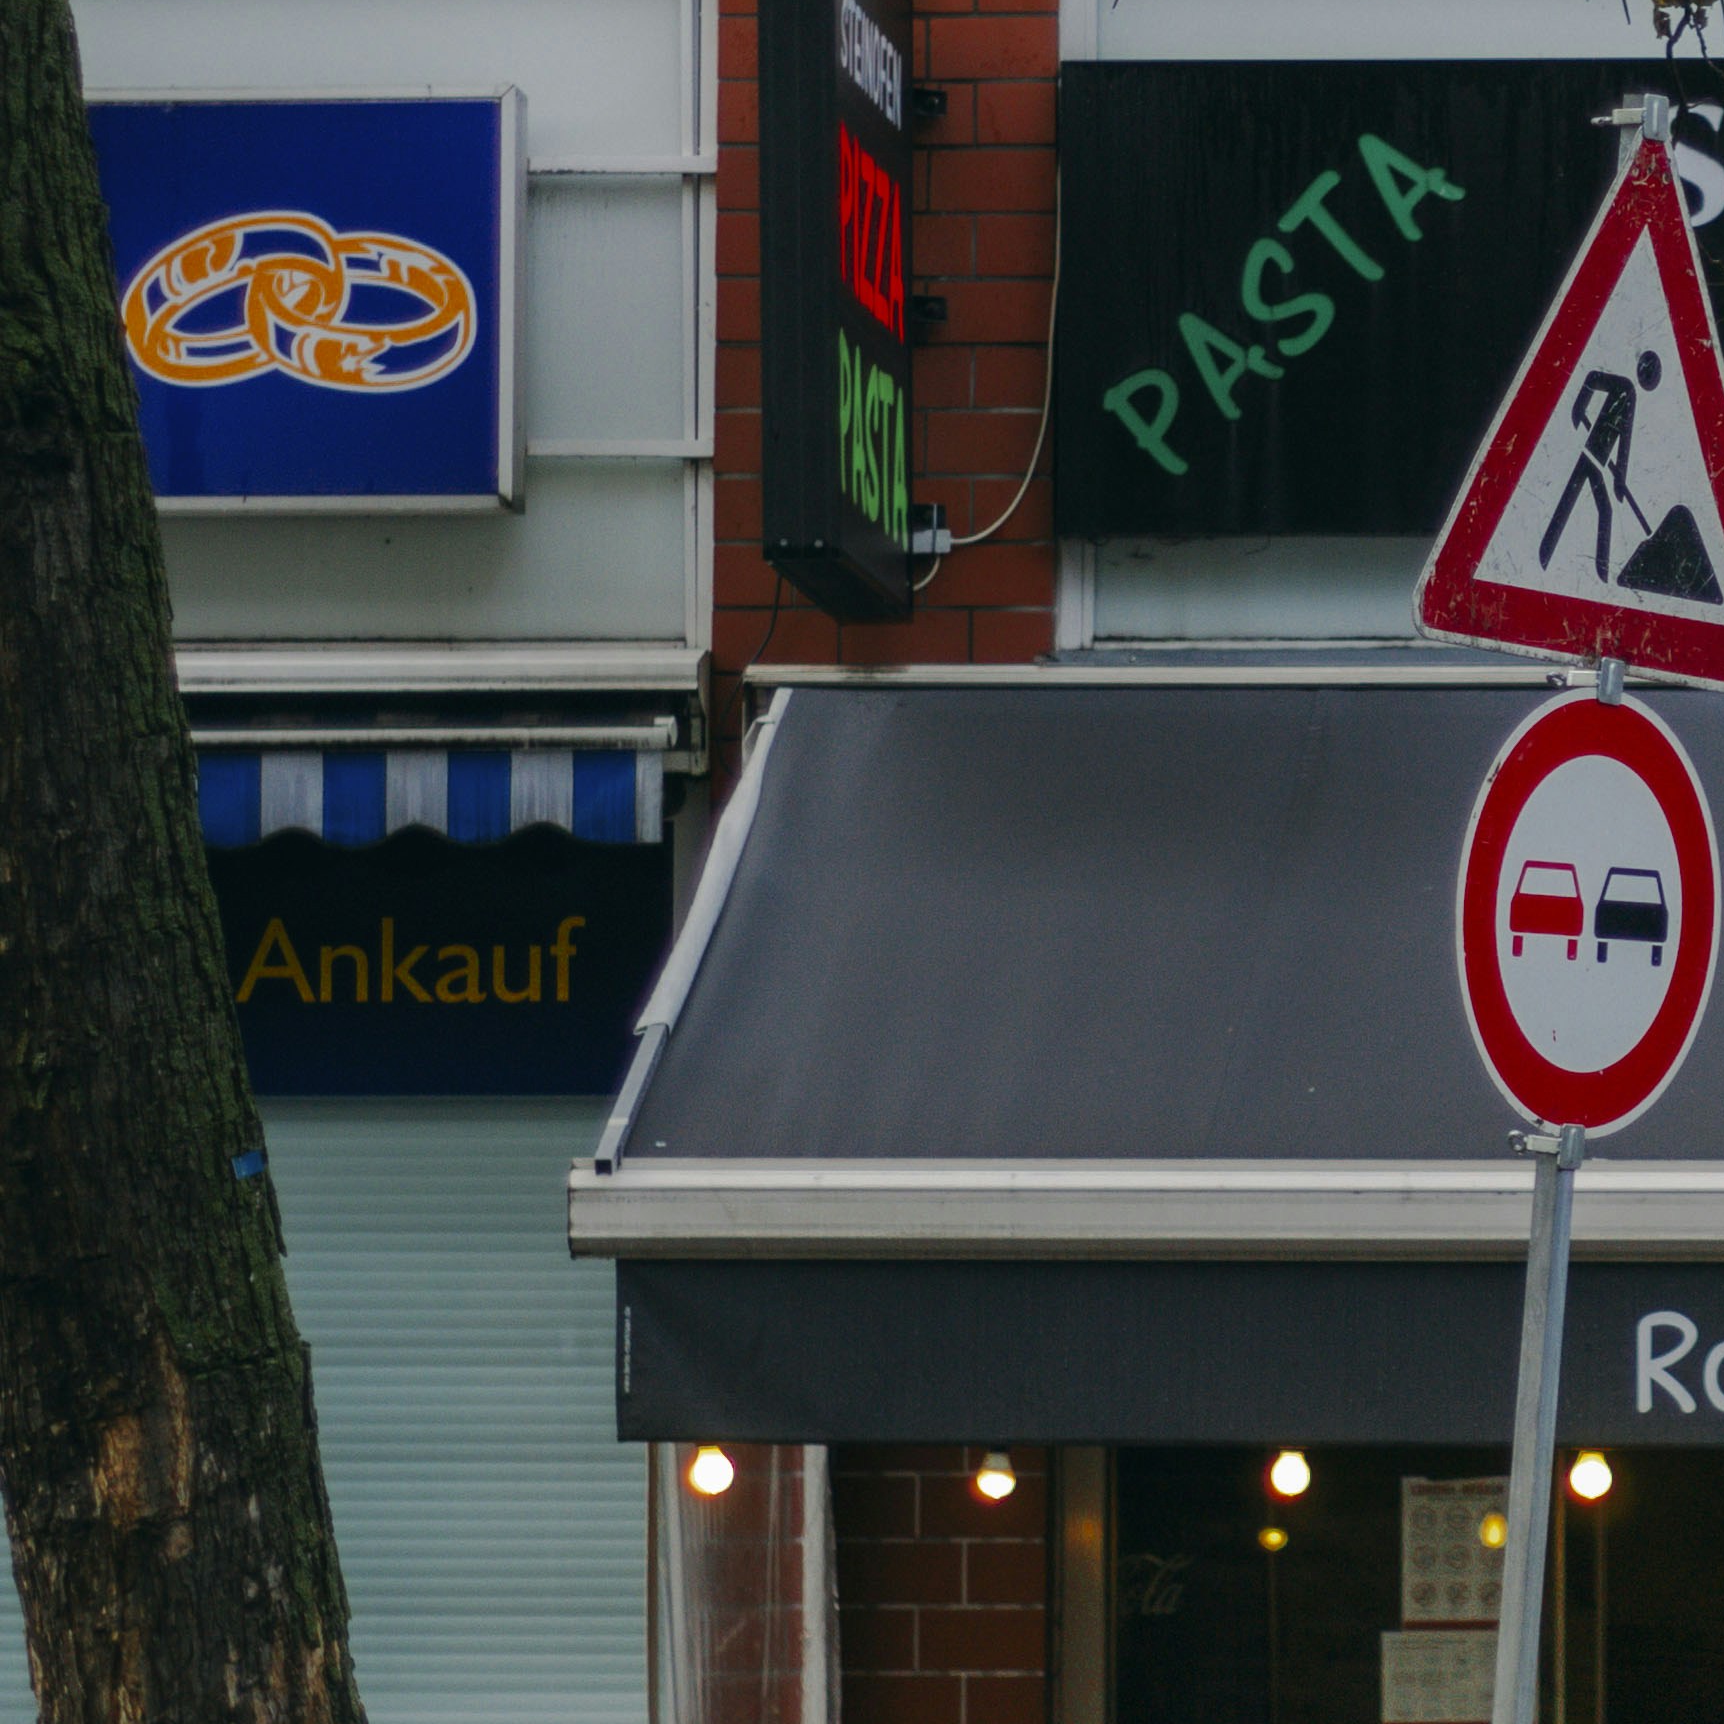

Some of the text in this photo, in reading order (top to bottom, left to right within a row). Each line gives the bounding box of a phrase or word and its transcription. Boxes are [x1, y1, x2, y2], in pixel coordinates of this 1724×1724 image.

[839, 122, 905, 344] PIZZA
[1102, 133, 1466, 475] PASTA
[838, 328, 909, 552] PASTA
[236, 917, 586, 1003] Ankauf
